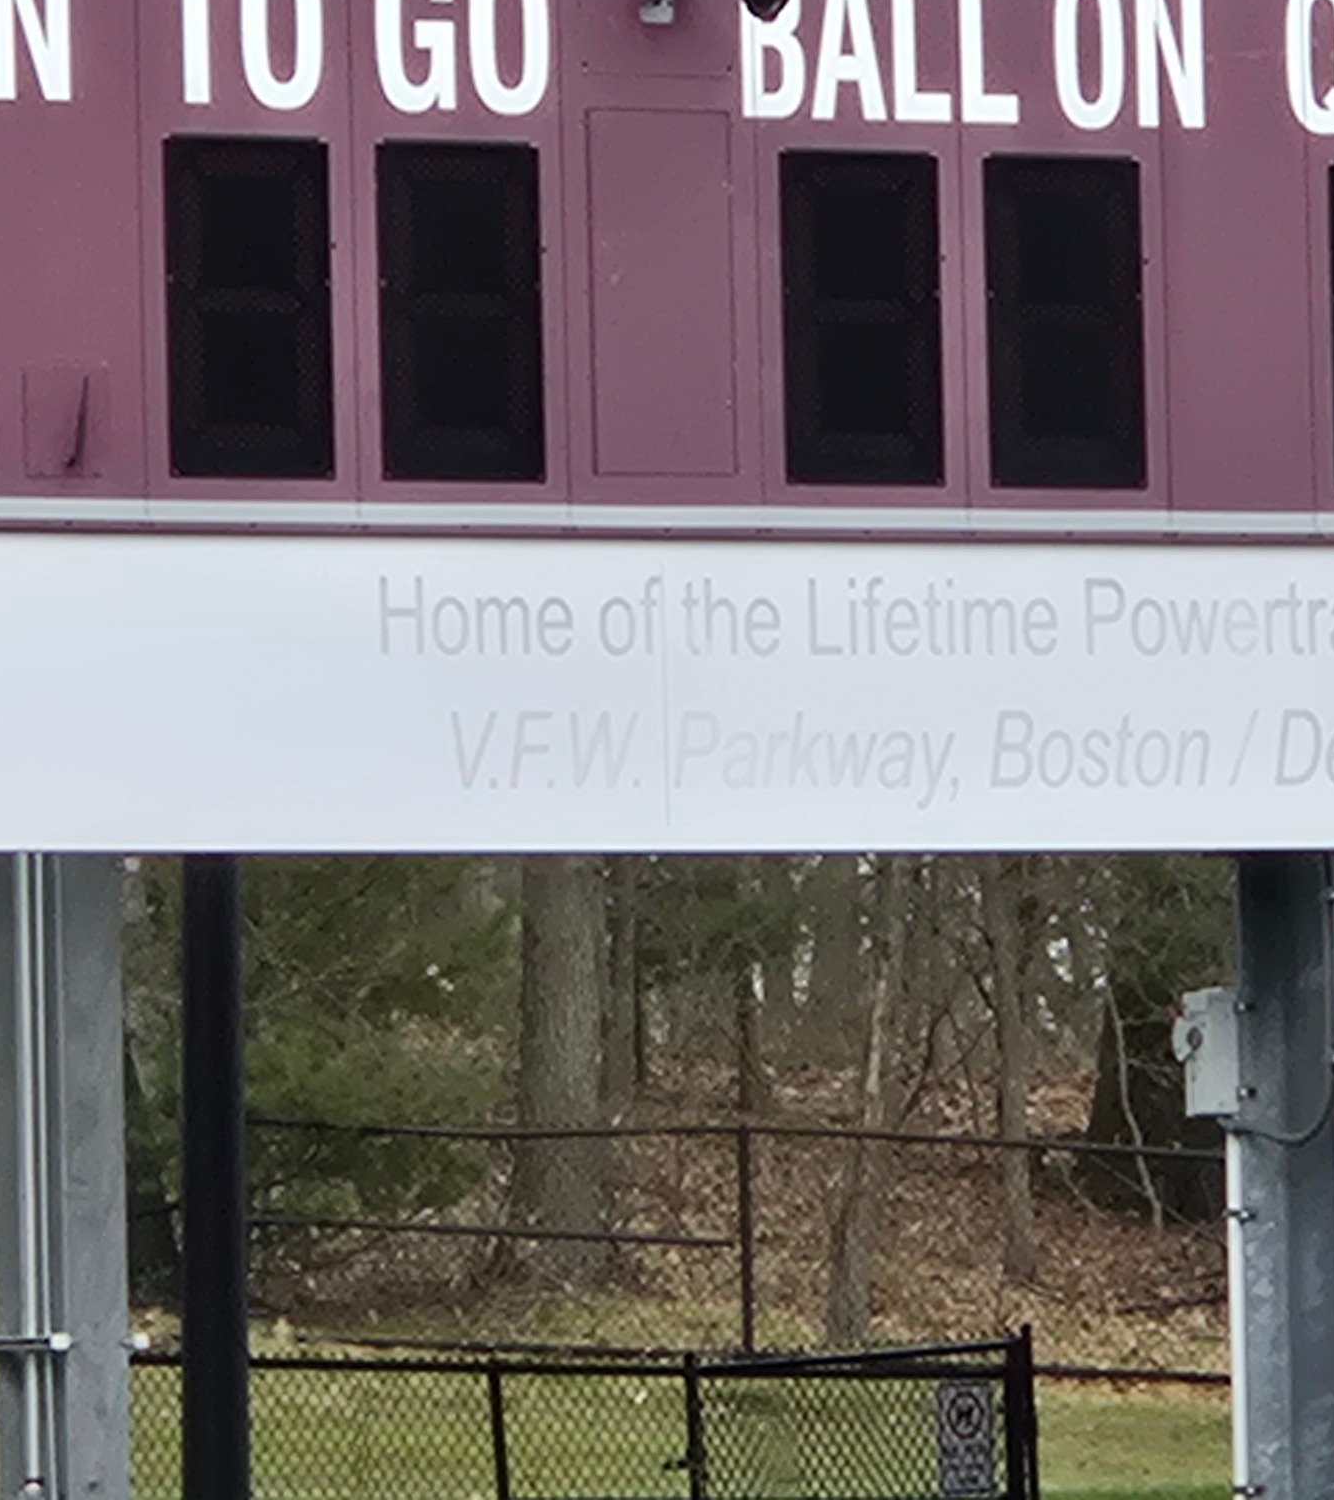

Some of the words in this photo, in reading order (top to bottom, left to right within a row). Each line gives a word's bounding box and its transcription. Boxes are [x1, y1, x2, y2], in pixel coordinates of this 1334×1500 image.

[378, 575, 575, 657] Home
[598, 575, 663, 657] of
[680, 577, 783, 657] the
[807, 577, 1059, 657] Lifetime
[449, 709, 643, 790] V.F.W.
[671, 709, 962, 811] Parkway,
[987, 708, 1213, 789] Boston
